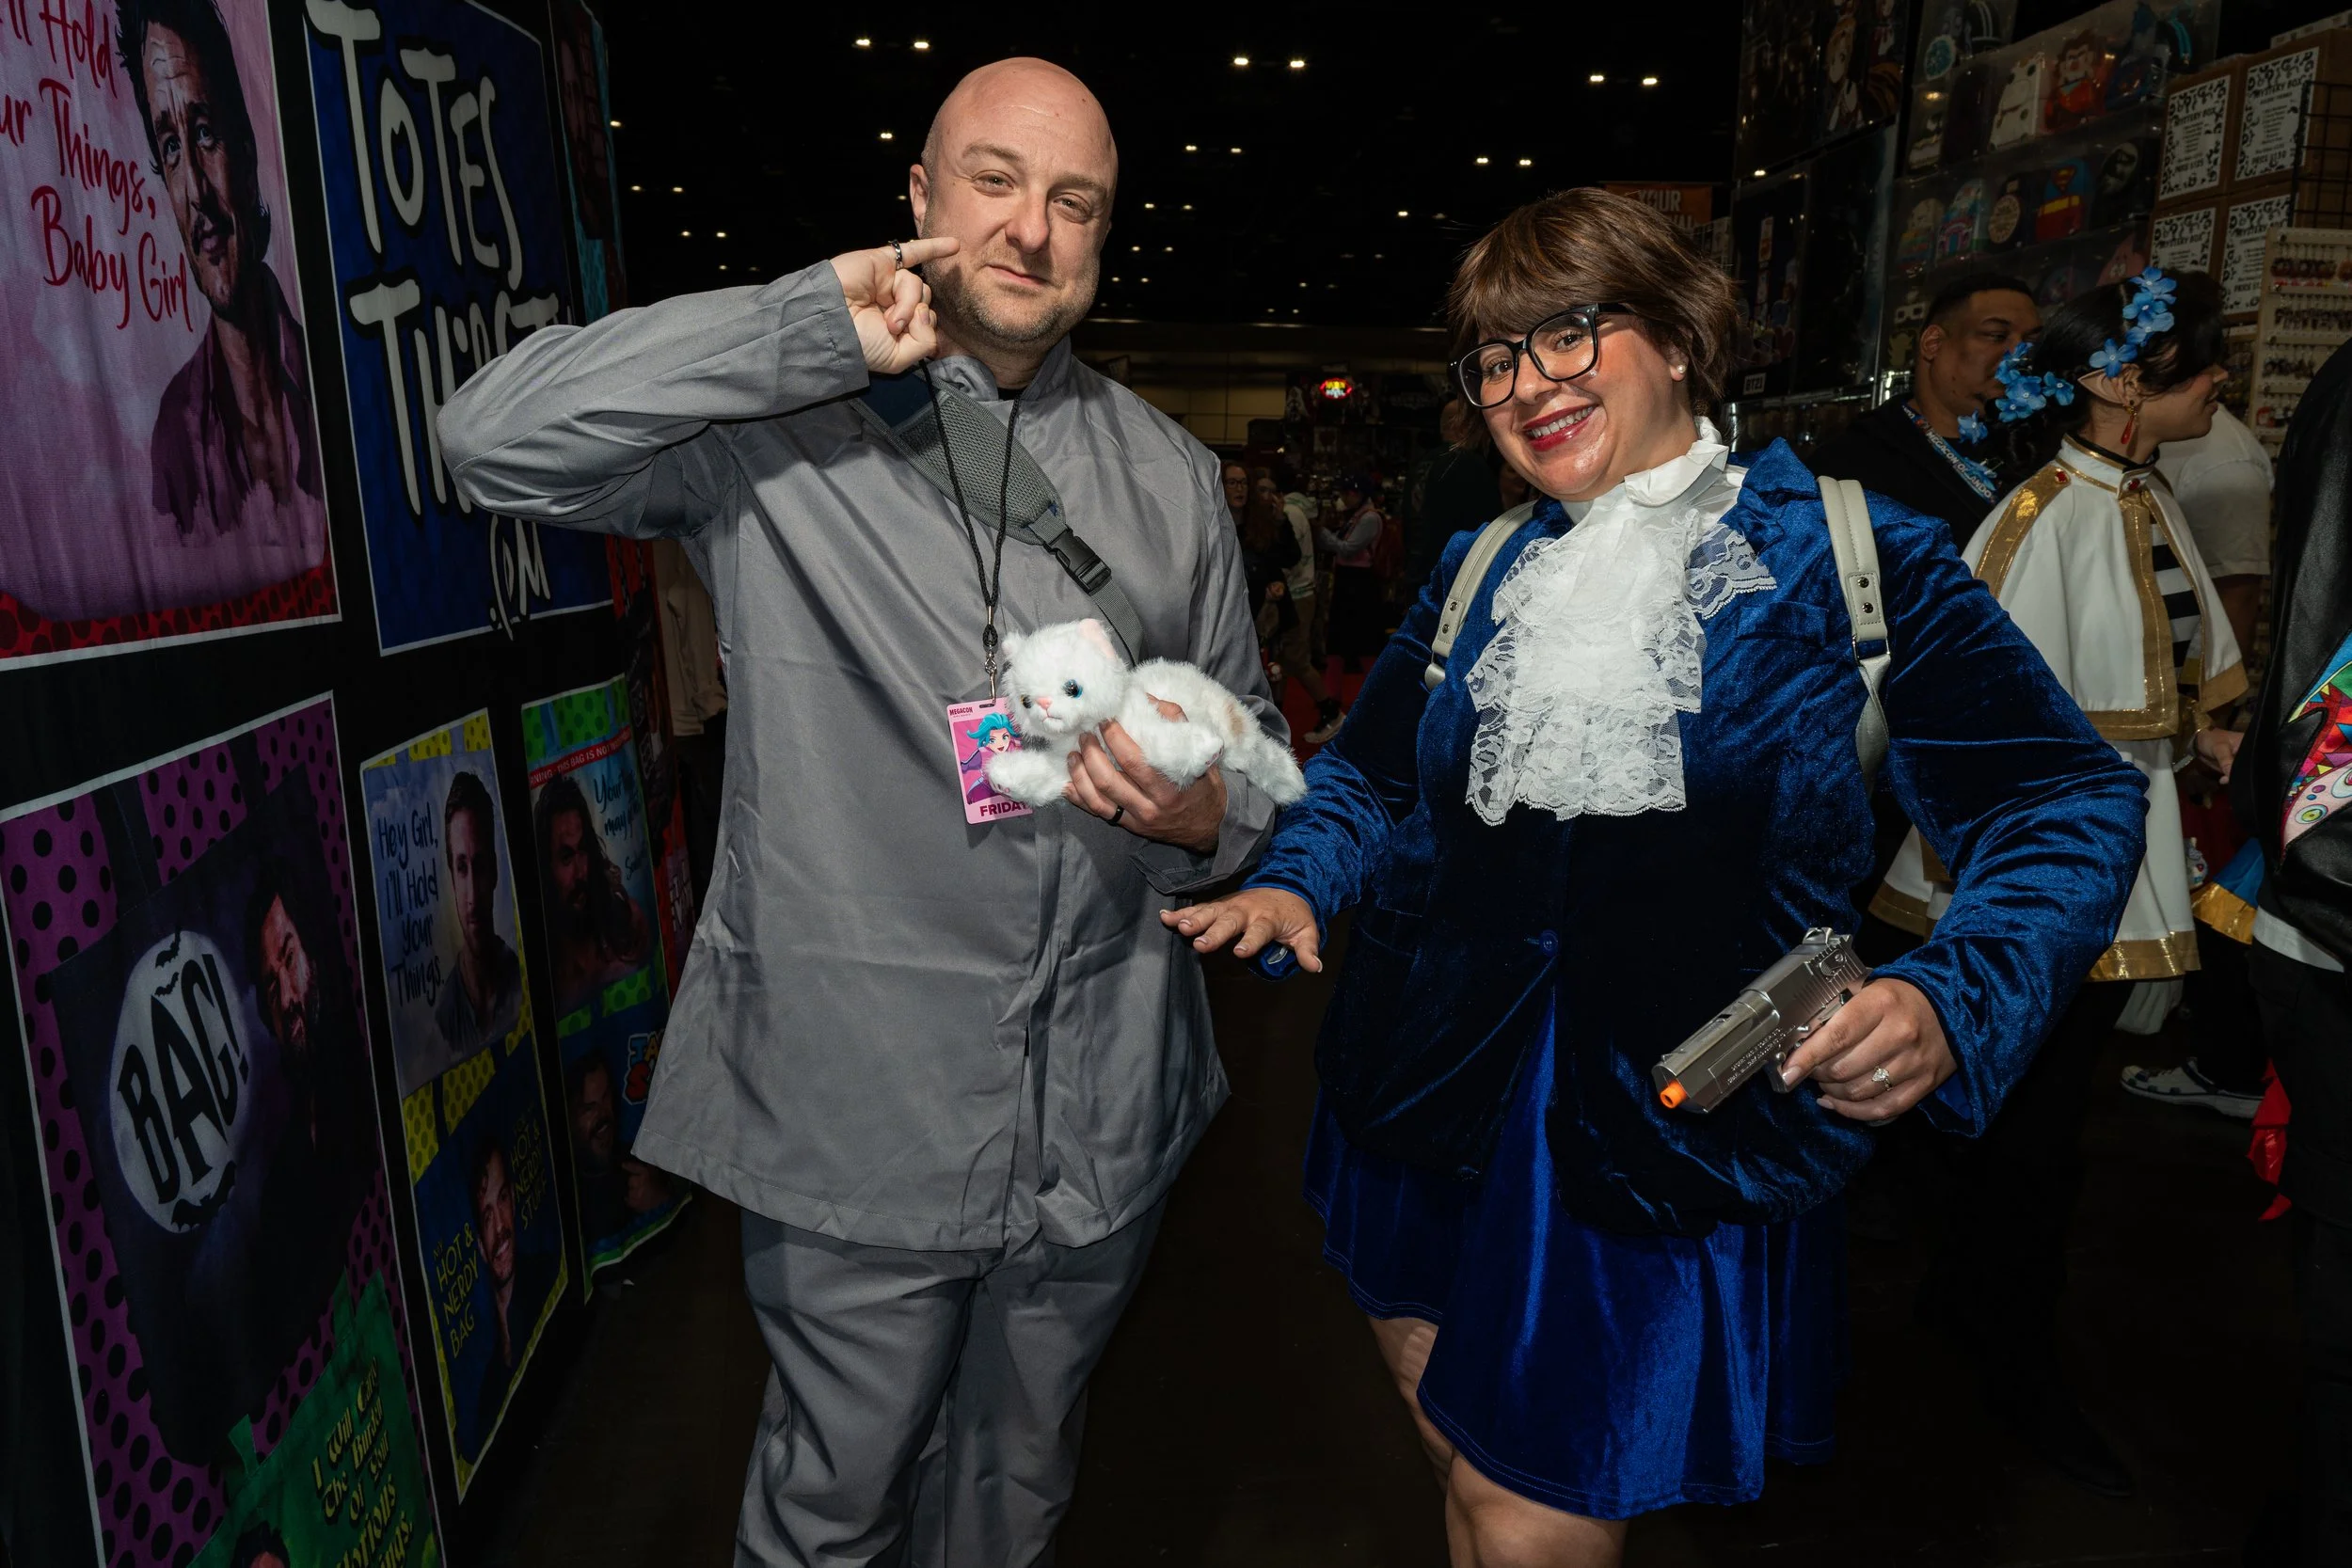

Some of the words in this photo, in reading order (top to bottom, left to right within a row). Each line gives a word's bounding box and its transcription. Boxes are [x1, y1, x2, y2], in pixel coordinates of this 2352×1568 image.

[39, 0, 118, 99] Hold
[0, 94, 32, 148] ur
[39, 78, 156, 236] Things,
[304, 0, 523, 292] TOTES
[31, 185, 131, 330] Baby
[138, 232, 194, 332] Girl
[1925, 430, 1960, 467] MEGACON
[949, 706, 974, 716] MEGACON
[570, 754, 585, 768] BAG
[585, 751, 596, 762] IS
[376, 817, 409, 870] Hey
[411, 801, 438, 848] Girl,
[385, 868, 404, 920] I'll
[406, 858, 439, 912] Hold
[390, 955, 445, 1006] Things.
[117, 953, 249, 1205] BAG!
[436, 1233, 465, 1293] HOT
[463, 1222, 475, 1250] &
[442, 1248, 480, 1325] NERDY
[449, 1301, 476, 1360] BAG
